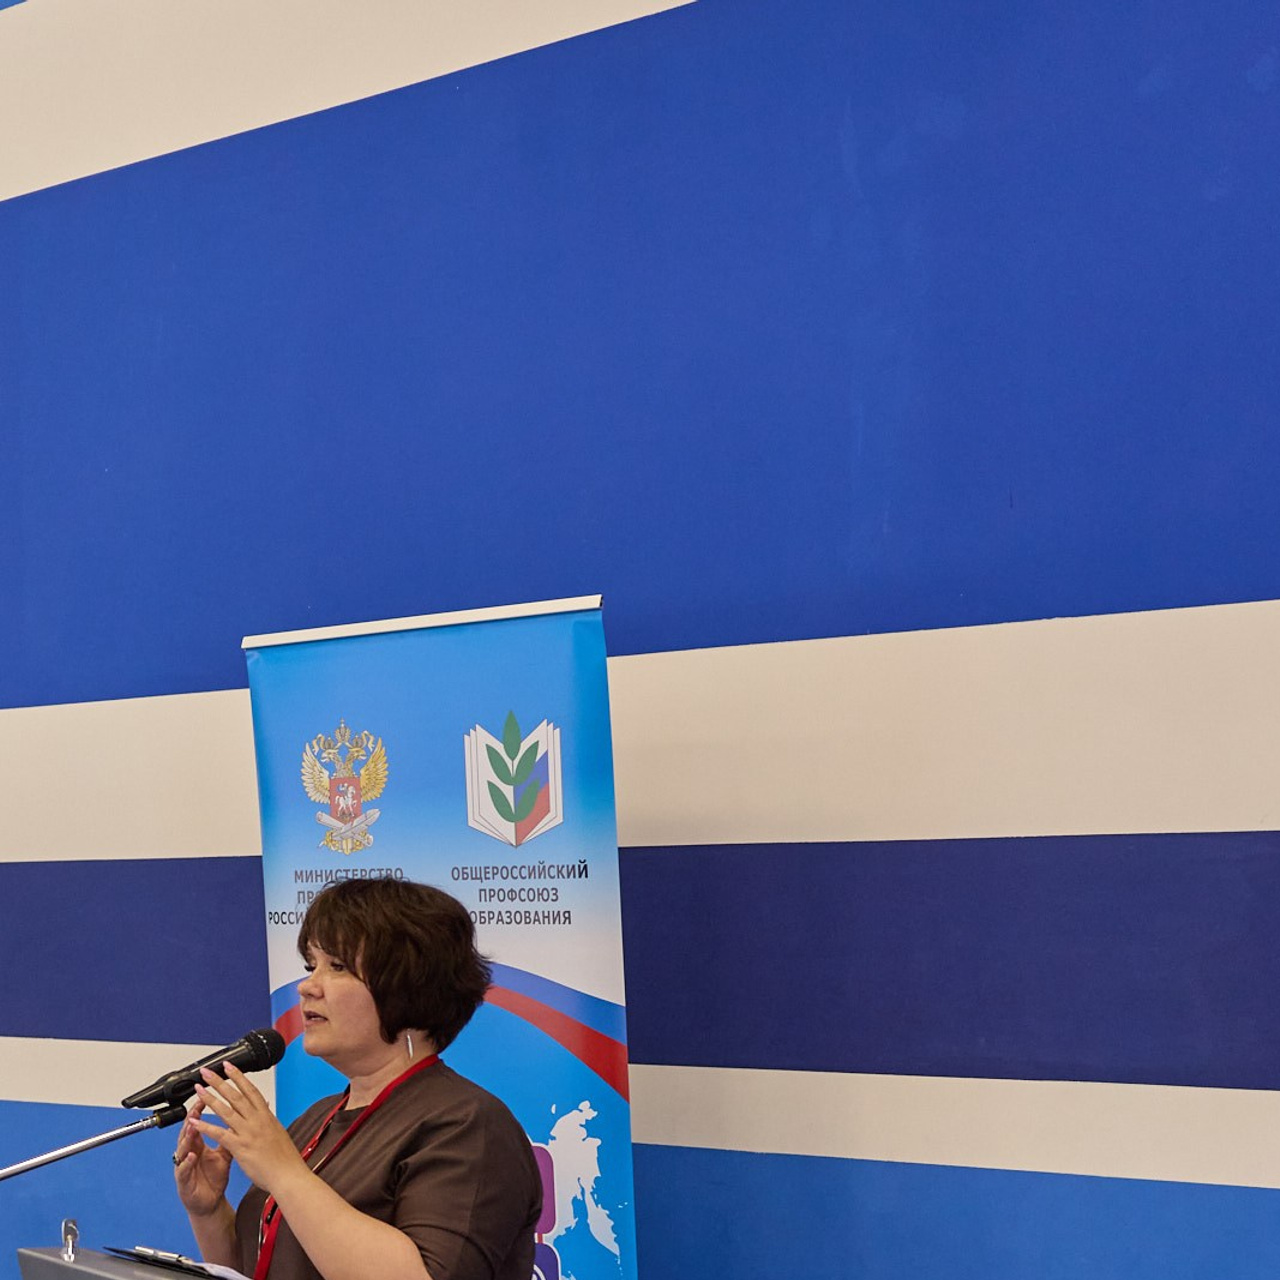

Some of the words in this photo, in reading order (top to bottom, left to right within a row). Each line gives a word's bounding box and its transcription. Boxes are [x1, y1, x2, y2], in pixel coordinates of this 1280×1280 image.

[294, 868, 403, 883] МИНИСТЕРСТВО
[451, 860, 588, 882] ОБЩЕРОССИЙСКИЙ
[479, 888, 559, 902] ПРОФСОЮЗ
[470, 910, 572, 925] ОБРАЗОВАНИЯ
